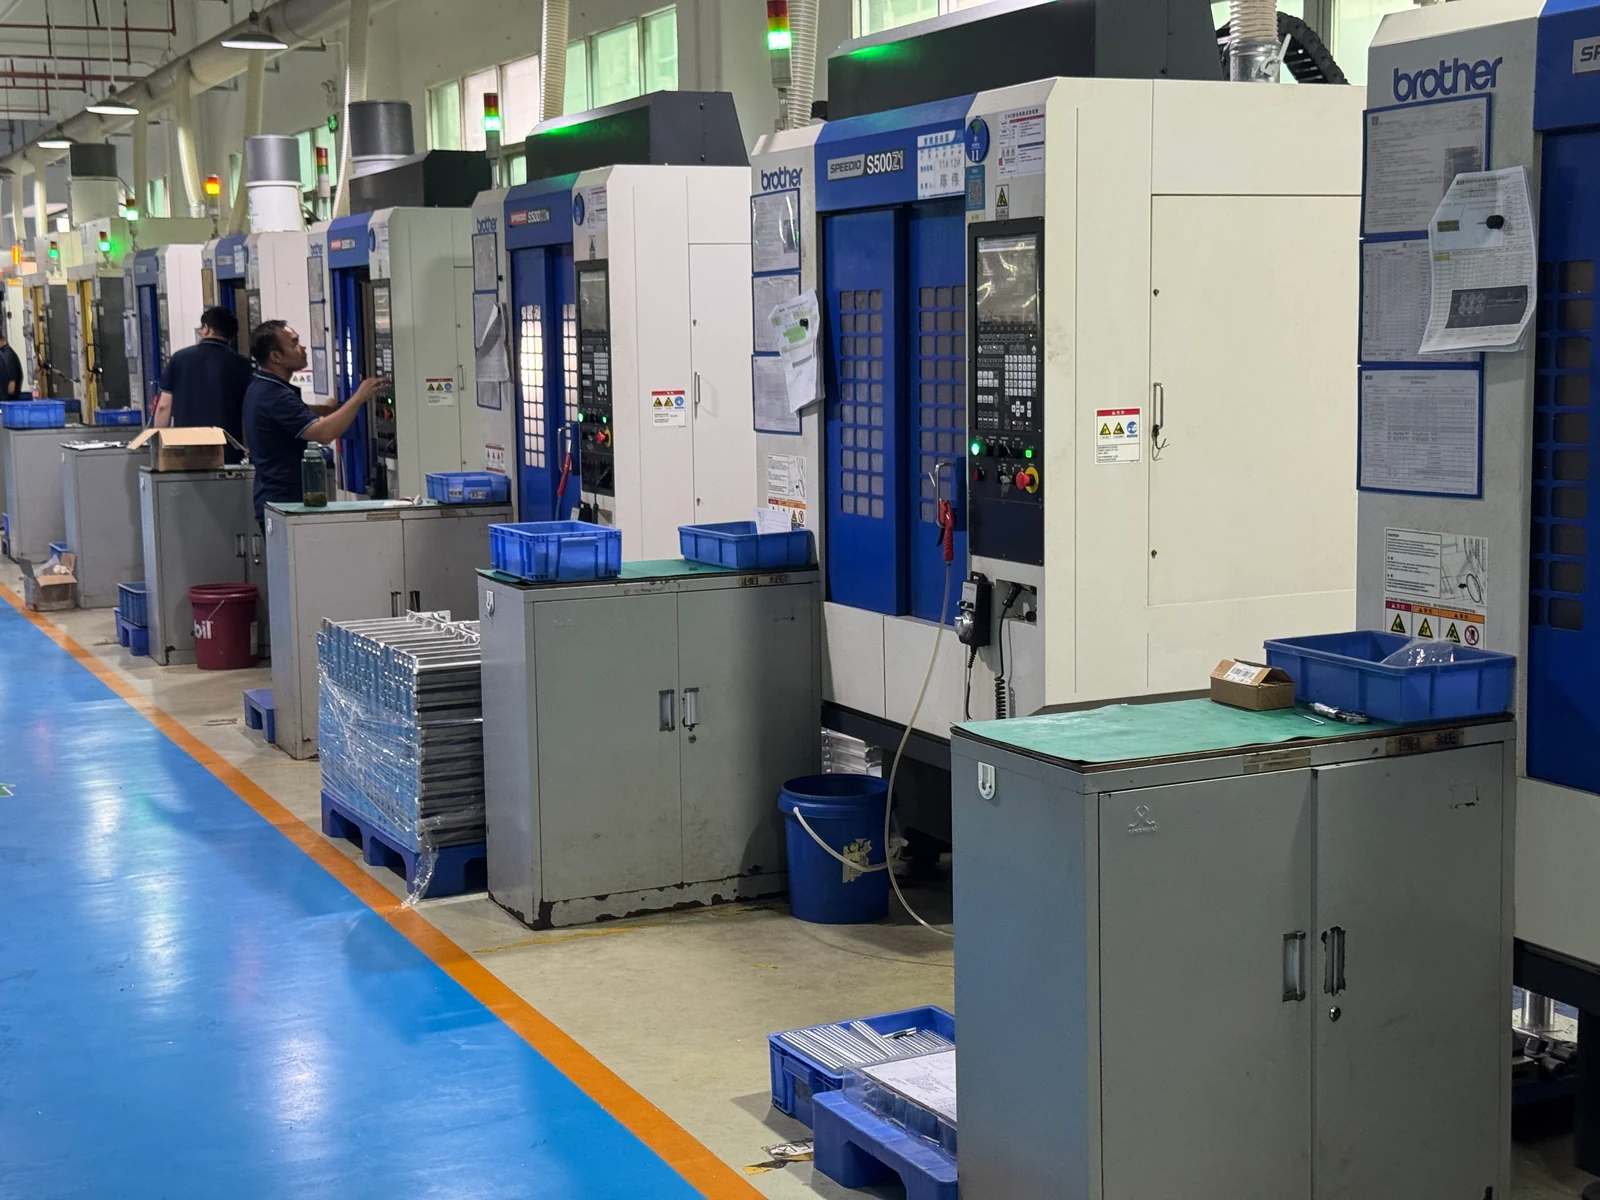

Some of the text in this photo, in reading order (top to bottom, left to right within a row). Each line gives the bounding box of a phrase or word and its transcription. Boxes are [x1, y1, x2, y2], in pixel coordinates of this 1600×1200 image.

[1393, 56, 1503, 102] brother
[829, 160, 862, 174] SPEEDIO
[866, 150, 904, 175] S500Z1
[760, 166, 804, 191] brother
